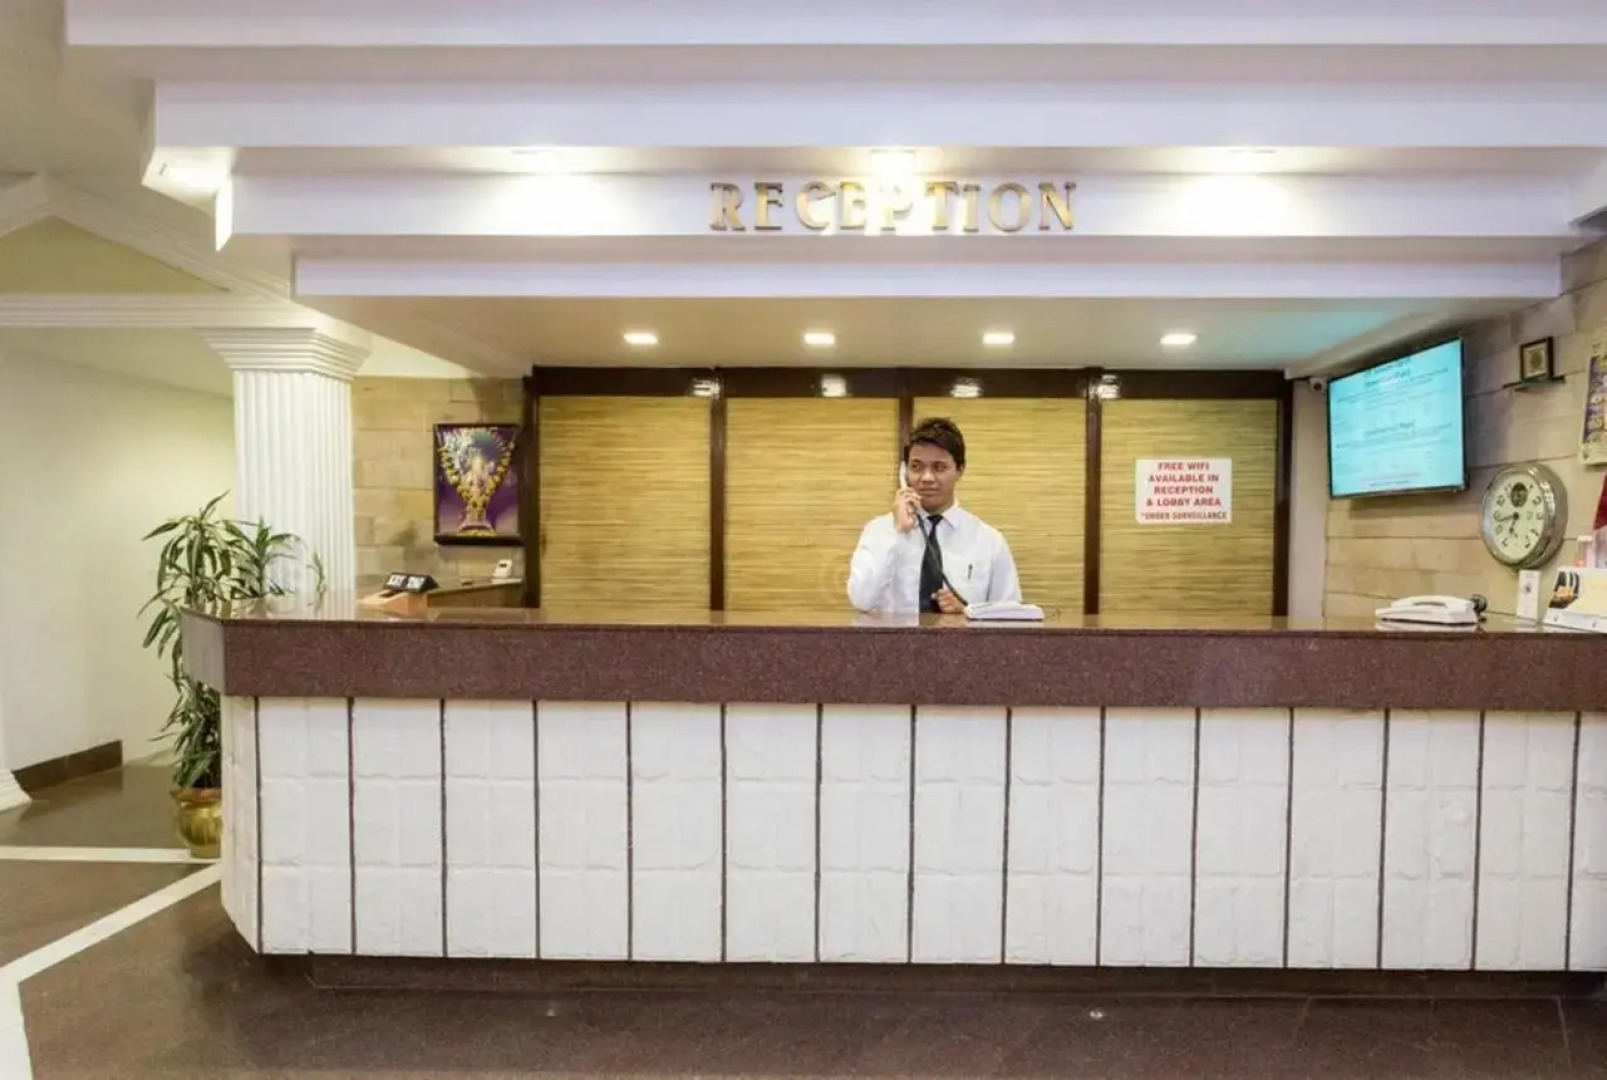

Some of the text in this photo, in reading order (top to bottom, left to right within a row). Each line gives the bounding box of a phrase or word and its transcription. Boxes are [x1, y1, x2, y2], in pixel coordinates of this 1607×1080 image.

[709, 181, 1077, 233] RECEPTION
[1158, 461, 1210, 470] FREE WIFI
[1148, 474, 1219, 482] AVAILABLE IN
[1154, 486, 1214, 494] RECEPTION
[1146, 498, 1222, 506] & LOBBY AREA
[1173, 511, 1227, 520] SURVEILLANCE
